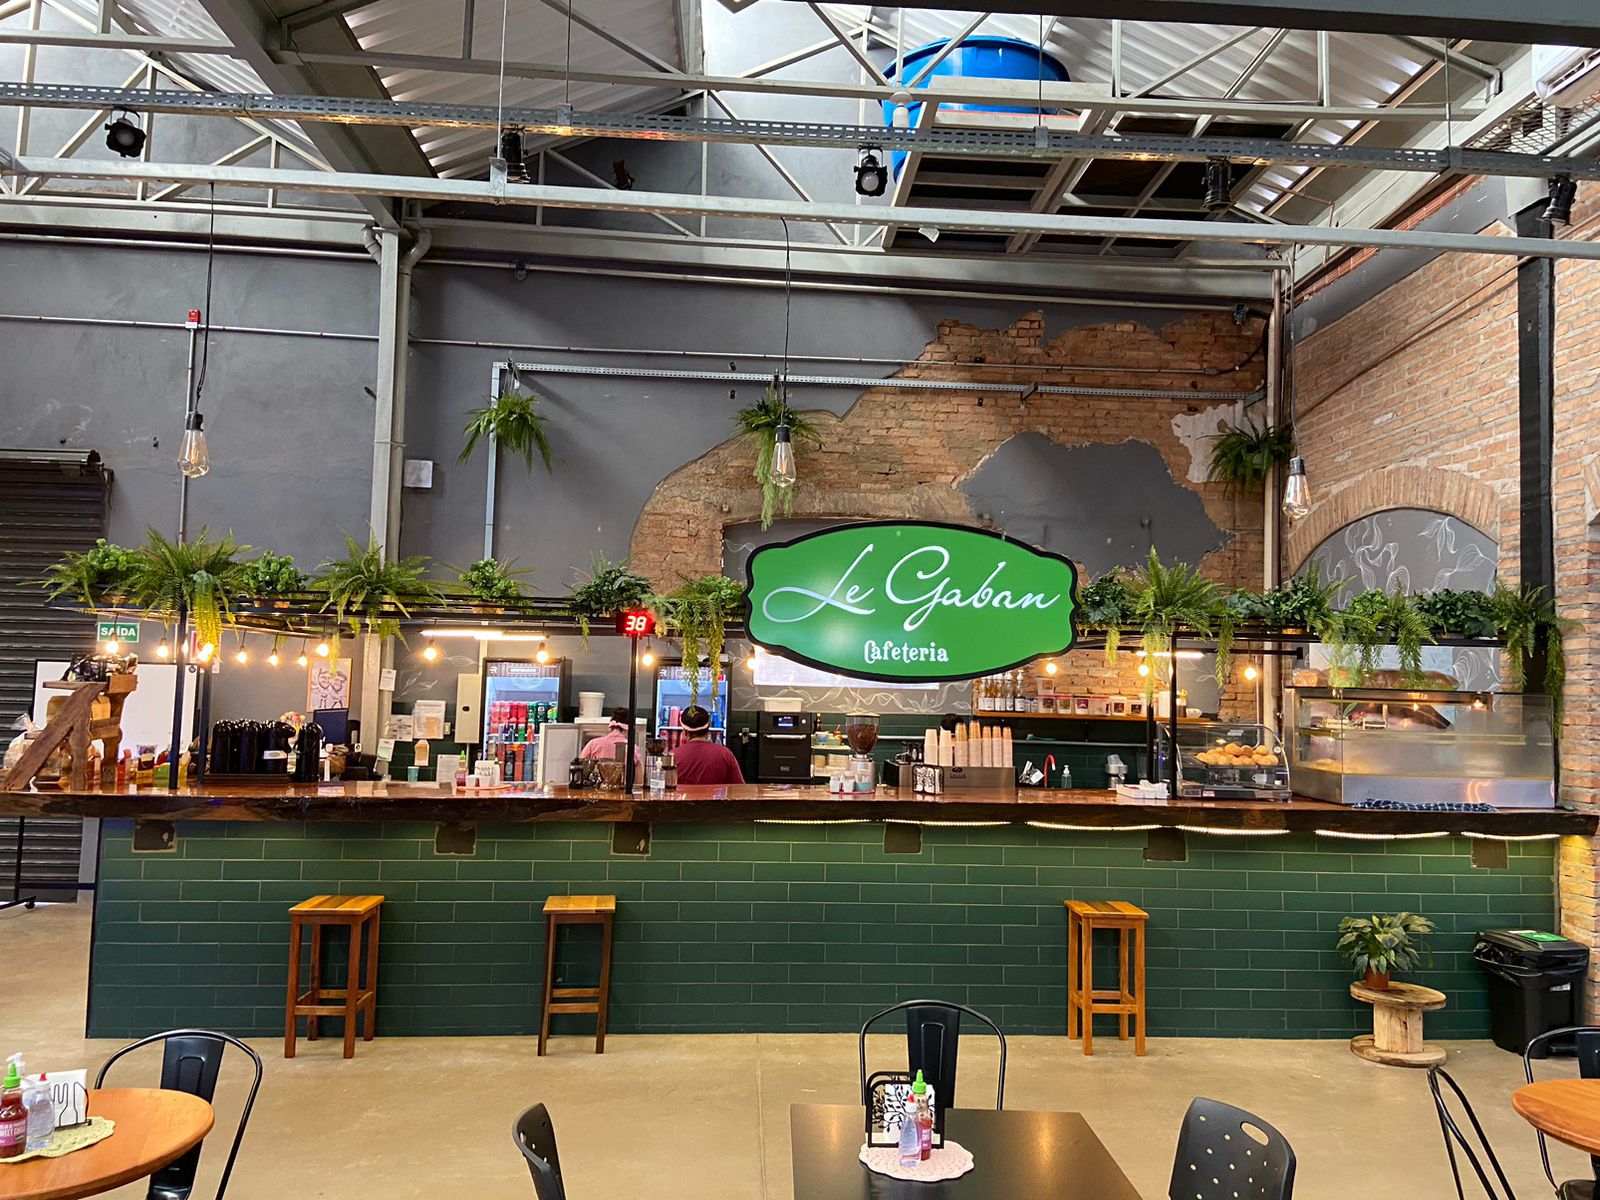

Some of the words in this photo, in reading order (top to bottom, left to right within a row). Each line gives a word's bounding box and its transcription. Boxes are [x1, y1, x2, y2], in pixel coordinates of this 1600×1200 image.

[762, 543, 876, 623] Le
[885, 545, 1061, 632] Gaban
[625, 615, 647, 631] 38
[863, 639, 949, 664] Cafeteria
